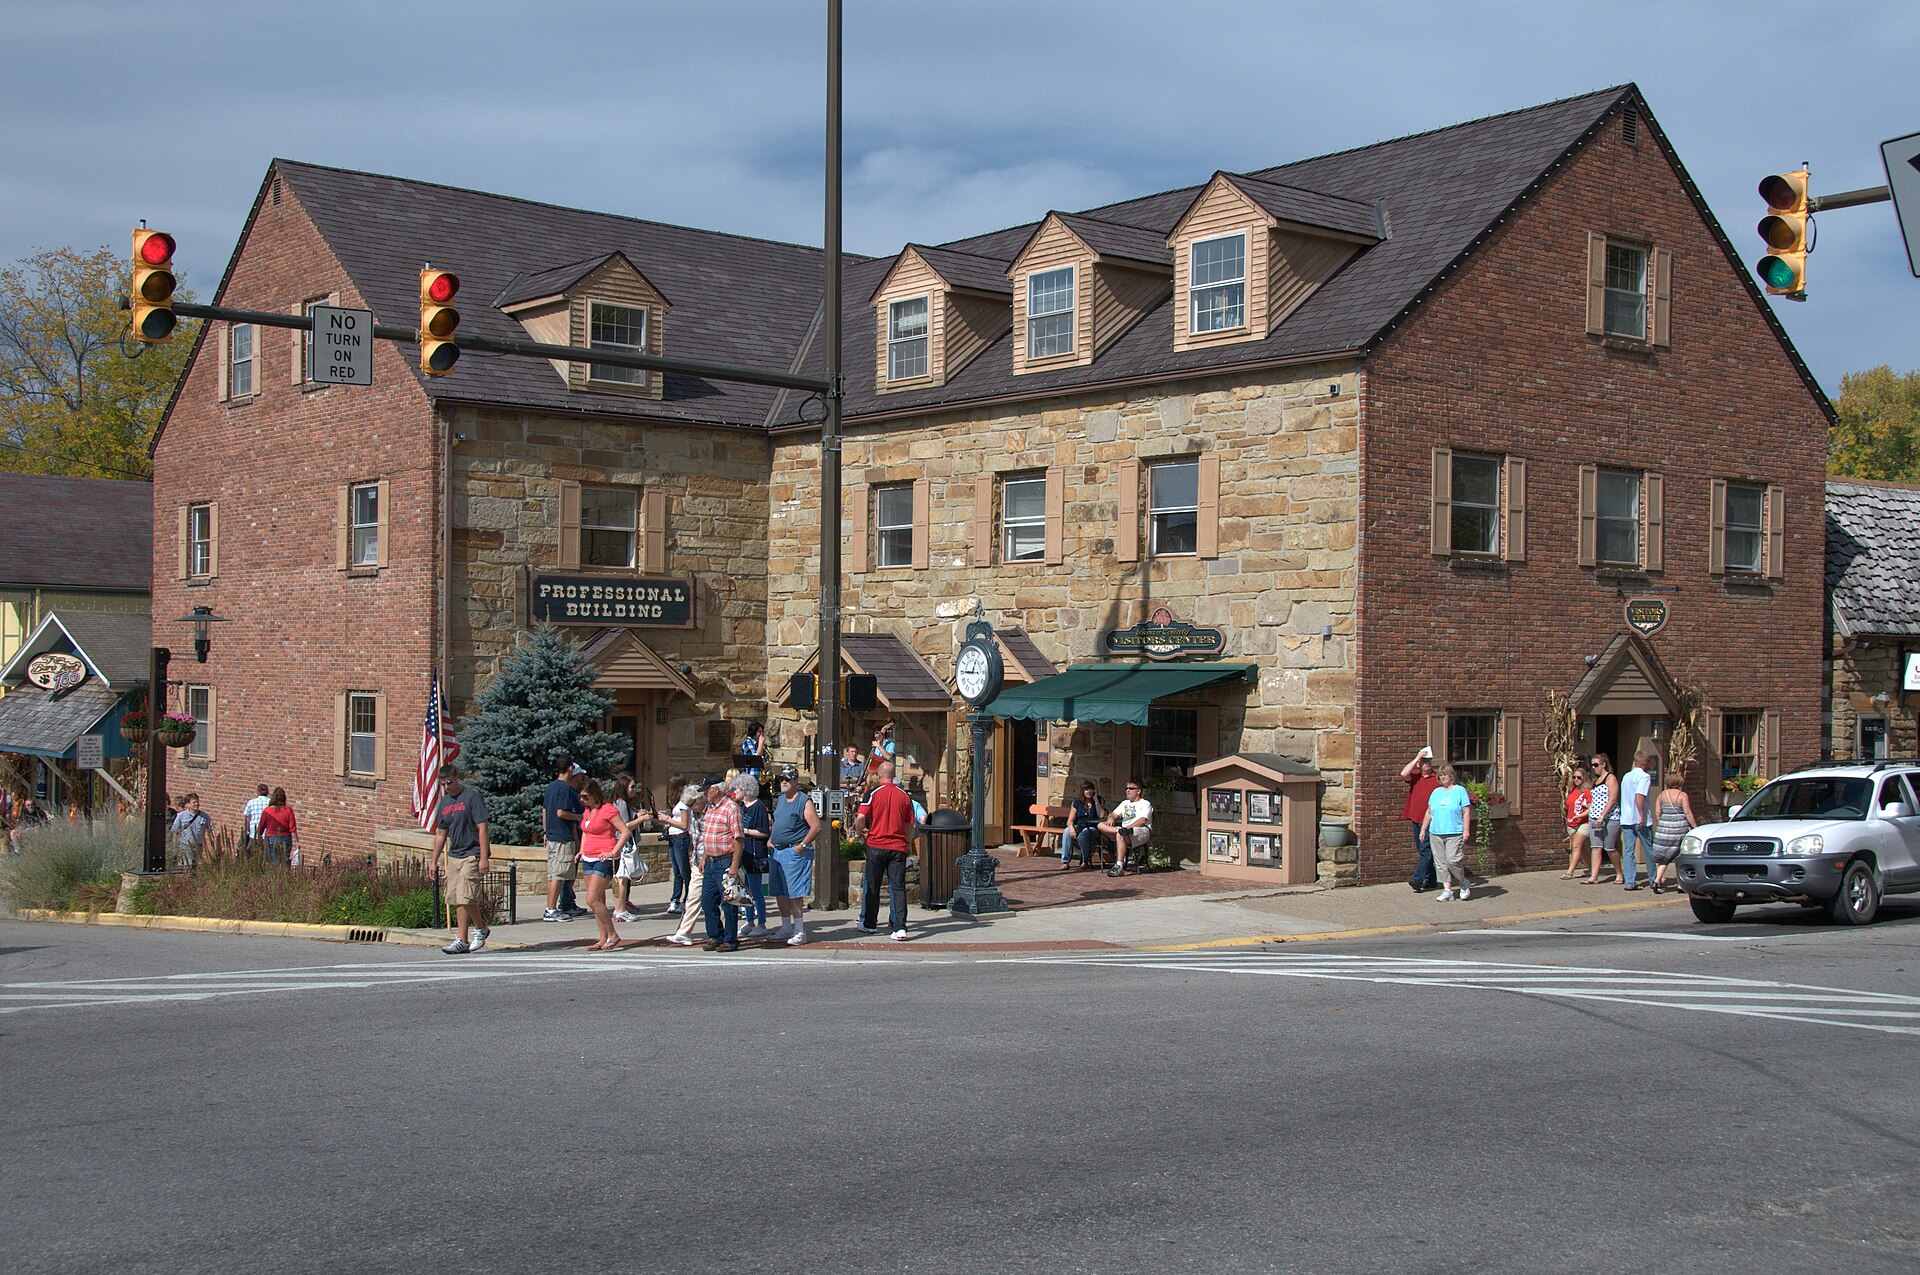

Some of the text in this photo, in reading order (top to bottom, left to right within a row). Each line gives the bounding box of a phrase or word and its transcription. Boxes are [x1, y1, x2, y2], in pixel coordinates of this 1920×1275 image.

[331, 314, 356, 330] NO
[326, 333, 360, 346] TURN
[334, 350, 352, 362] ON
[330, 366, 355, 378] RED
[539, 584, 685, 602] PROFESSIONAL
[566, 603, 663, 618] BUILDING
[1112, 635, 1216, 645] VISITORS CENTER
